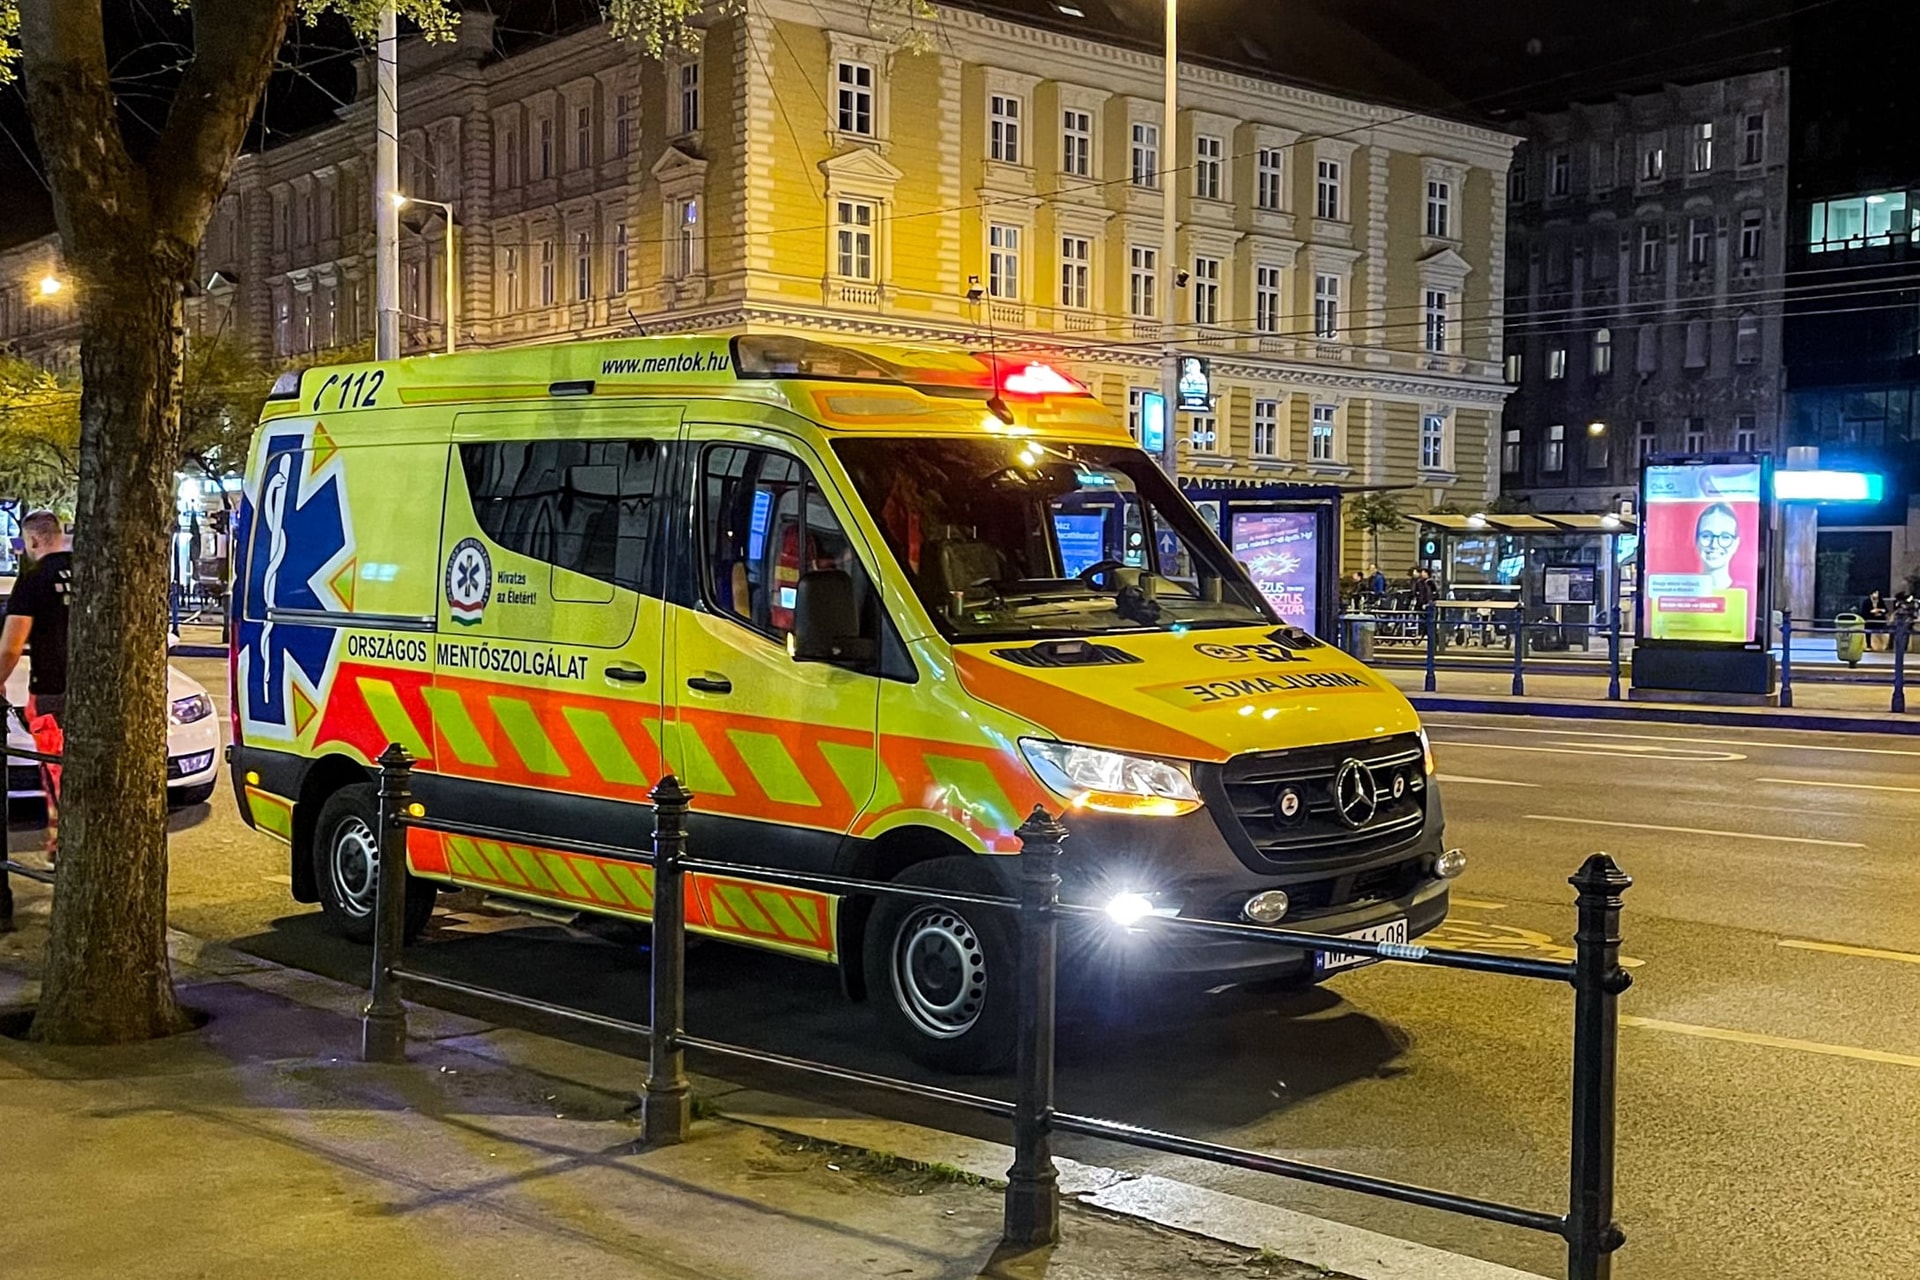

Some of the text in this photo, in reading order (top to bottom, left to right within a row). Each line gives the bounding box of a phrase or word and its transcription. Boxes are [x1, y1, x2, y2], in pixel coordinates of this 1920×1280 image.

[602, 350, 729, 375] www.mentok.hu
[339, 369, 384, 409] 112
[497, 592, 505, 603] az
[1258, 578, 1284, 593] ÉZUS
[348, 633, 588, 680] ORSZÁGOS MENTŐSZOLGÁLAT
